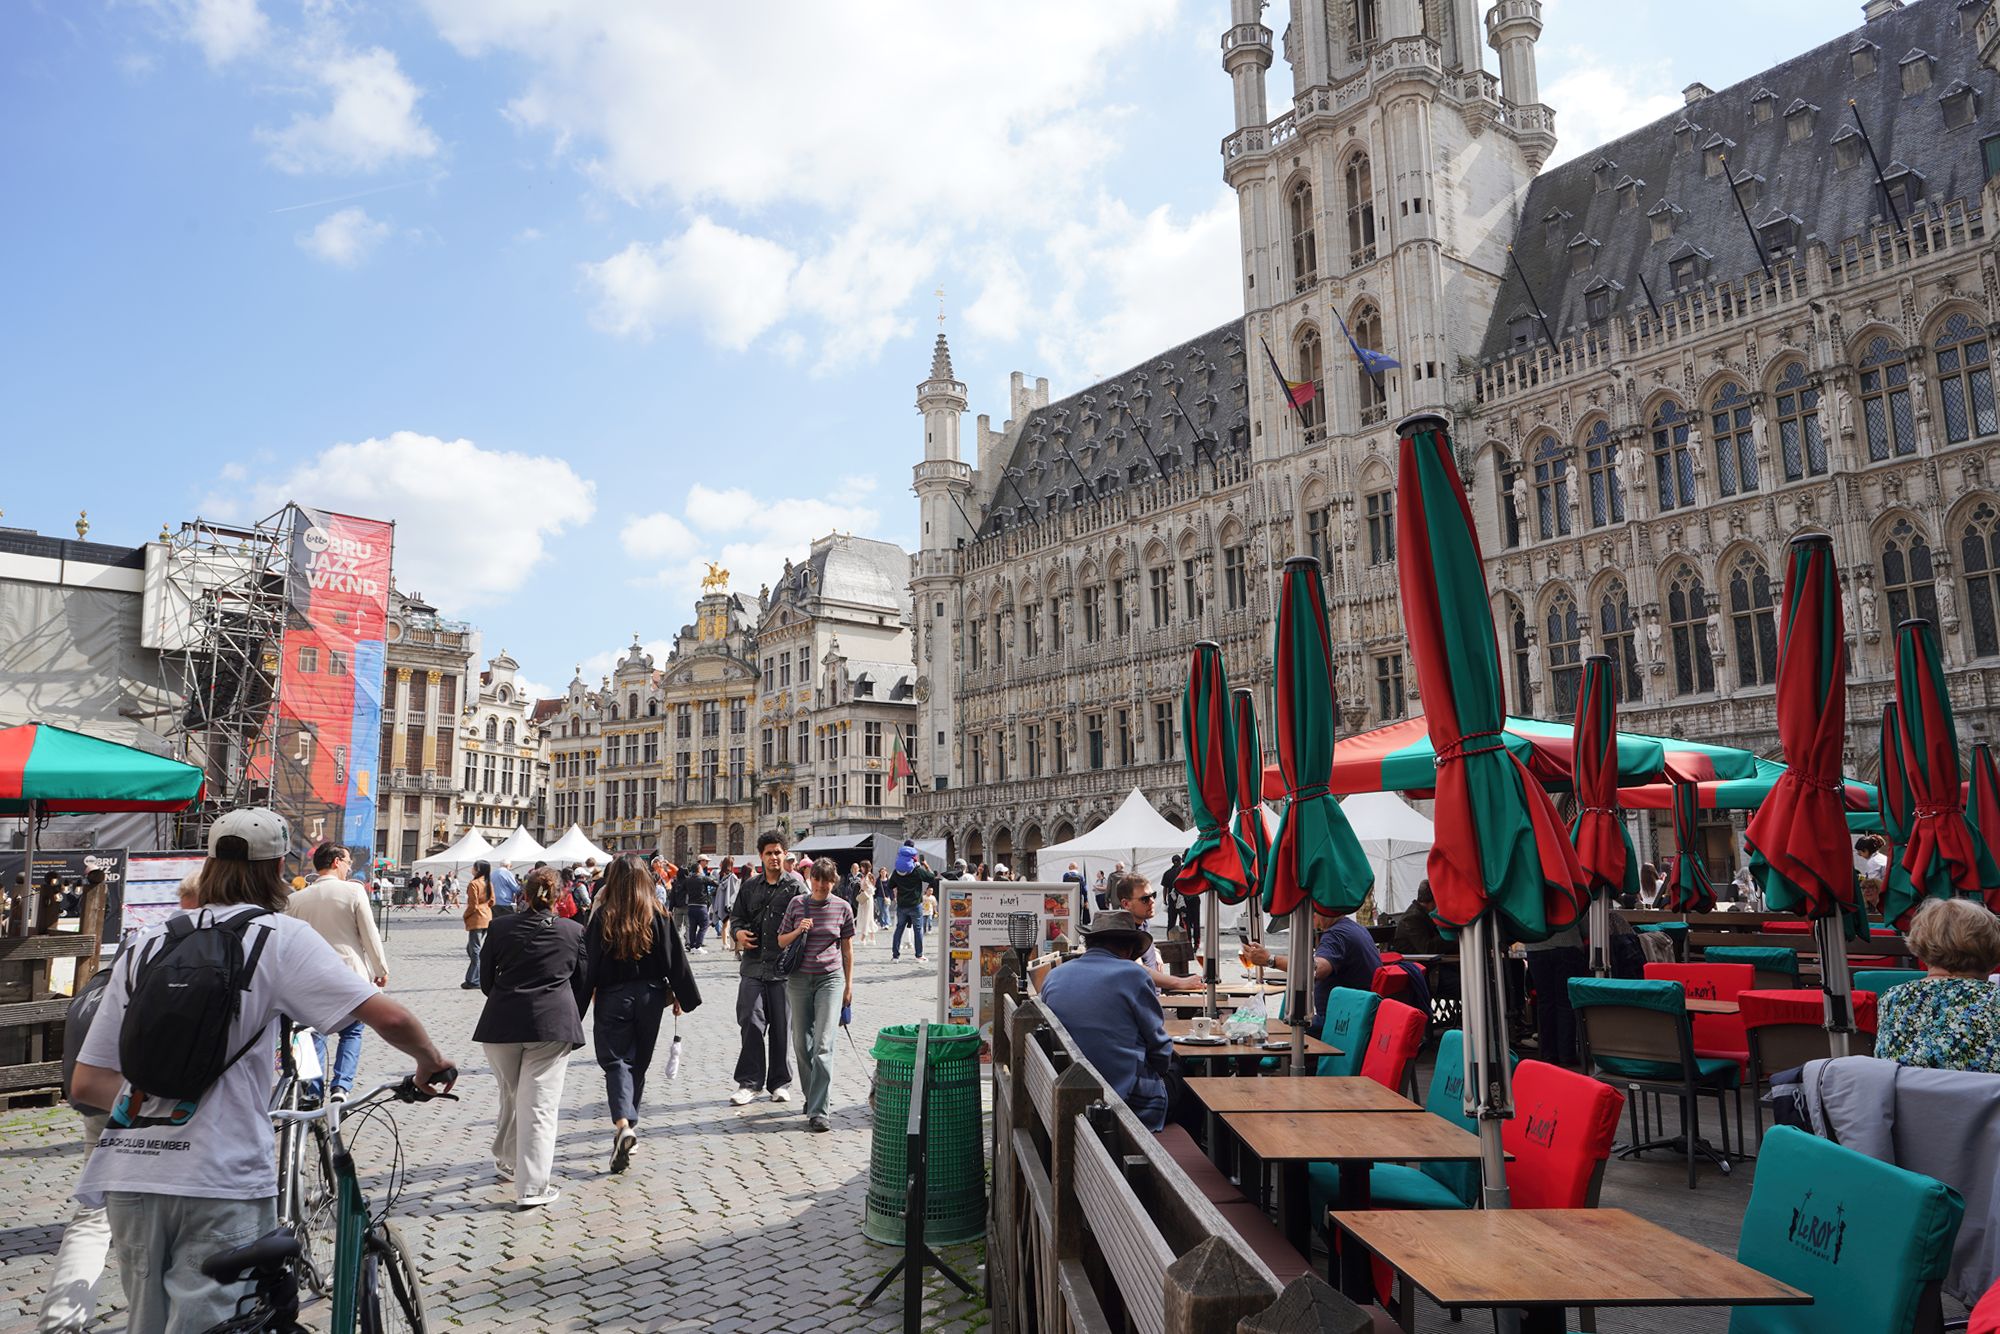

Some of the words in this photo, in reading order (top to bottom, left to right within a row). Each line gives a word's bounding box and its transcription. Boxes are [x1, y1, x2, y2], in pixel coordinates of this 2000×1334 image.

[327, 536, 372, 560] BRU
[305, 552, 359, 576] JAZZ
[305, 569, 378, 596] WKND
[95, 857, 118, 866] BRU
[104, 873, 121, 882] ND
[146, 1139, 191, 1151] MEMBER
